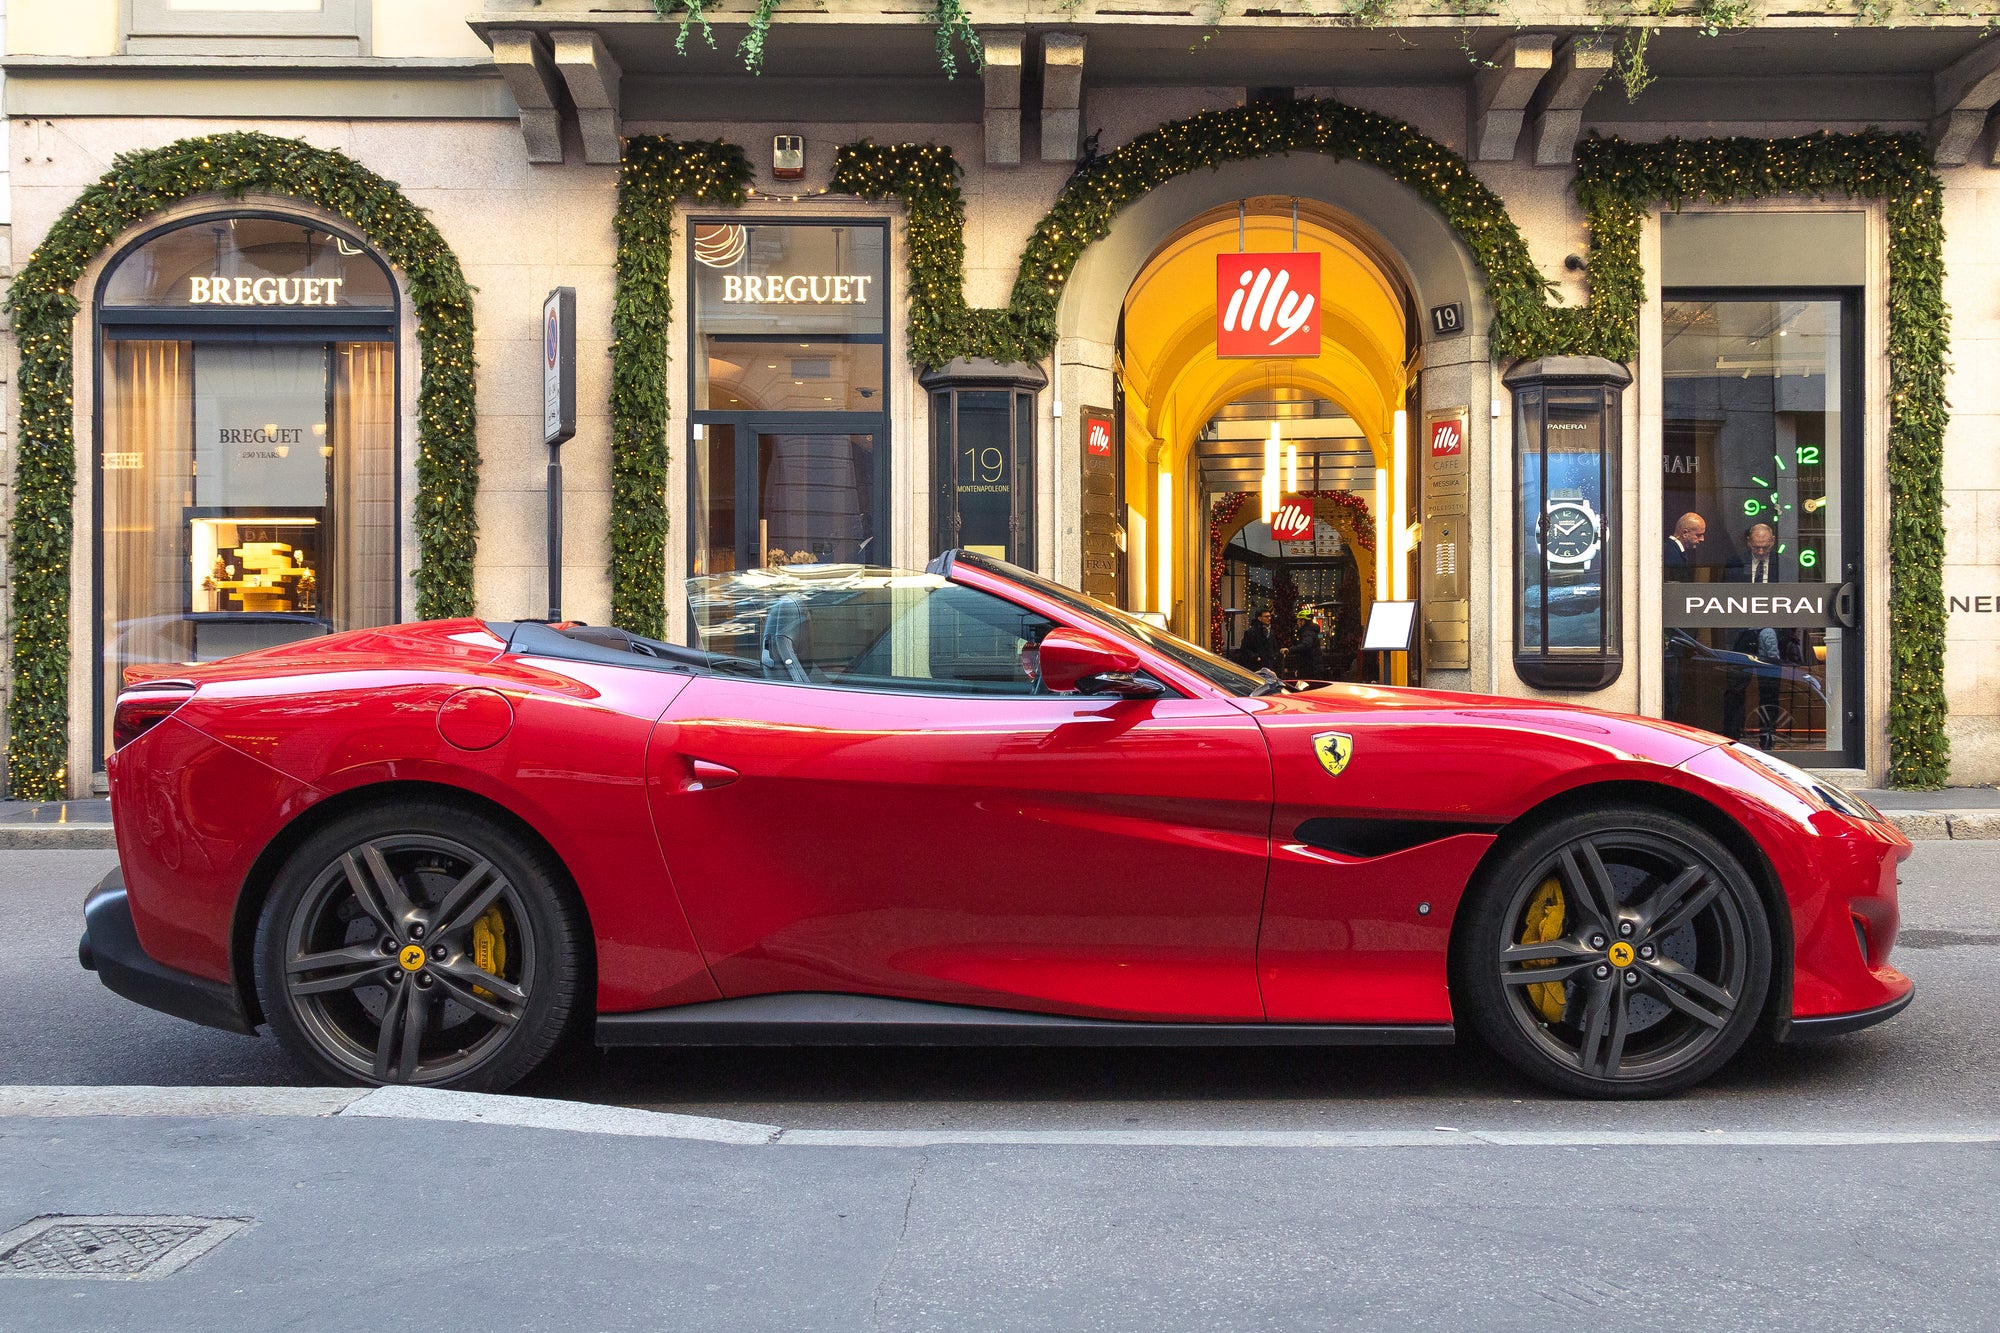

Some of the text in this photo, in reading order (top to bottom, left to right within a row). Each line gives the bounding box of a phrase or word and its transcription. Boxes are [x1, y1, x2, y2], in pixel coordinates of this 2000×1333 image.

[189, 276, 343, 305] BREGUET
[723, 275, 872, 302] BREGUET
[1223, 267, 1315, 345] illy
[1435, 307, 1456, 330] 19
[219, 428, 303, 444] BREGUET
[1089, 425, 1109, 453] illy
[1433, 426, 1460, 453] illy
[256, 451, 280, 459] YEARS
[1795, 446, 1819, 464] 12
[964, 447, 1003, 482] 19
[957, 484, 1010, 493] MONTENAPOLEONE
[1433, 479, 1460, 488] MESSIKA
[1743, 499, 1760, 516] 9
[1273, 504, 1311, 537] illy
[1800, 549, 1816, 567] 6
[1685, 597, 1823, 614] PANERAI
[1950, 596, 2000, 612] NE
